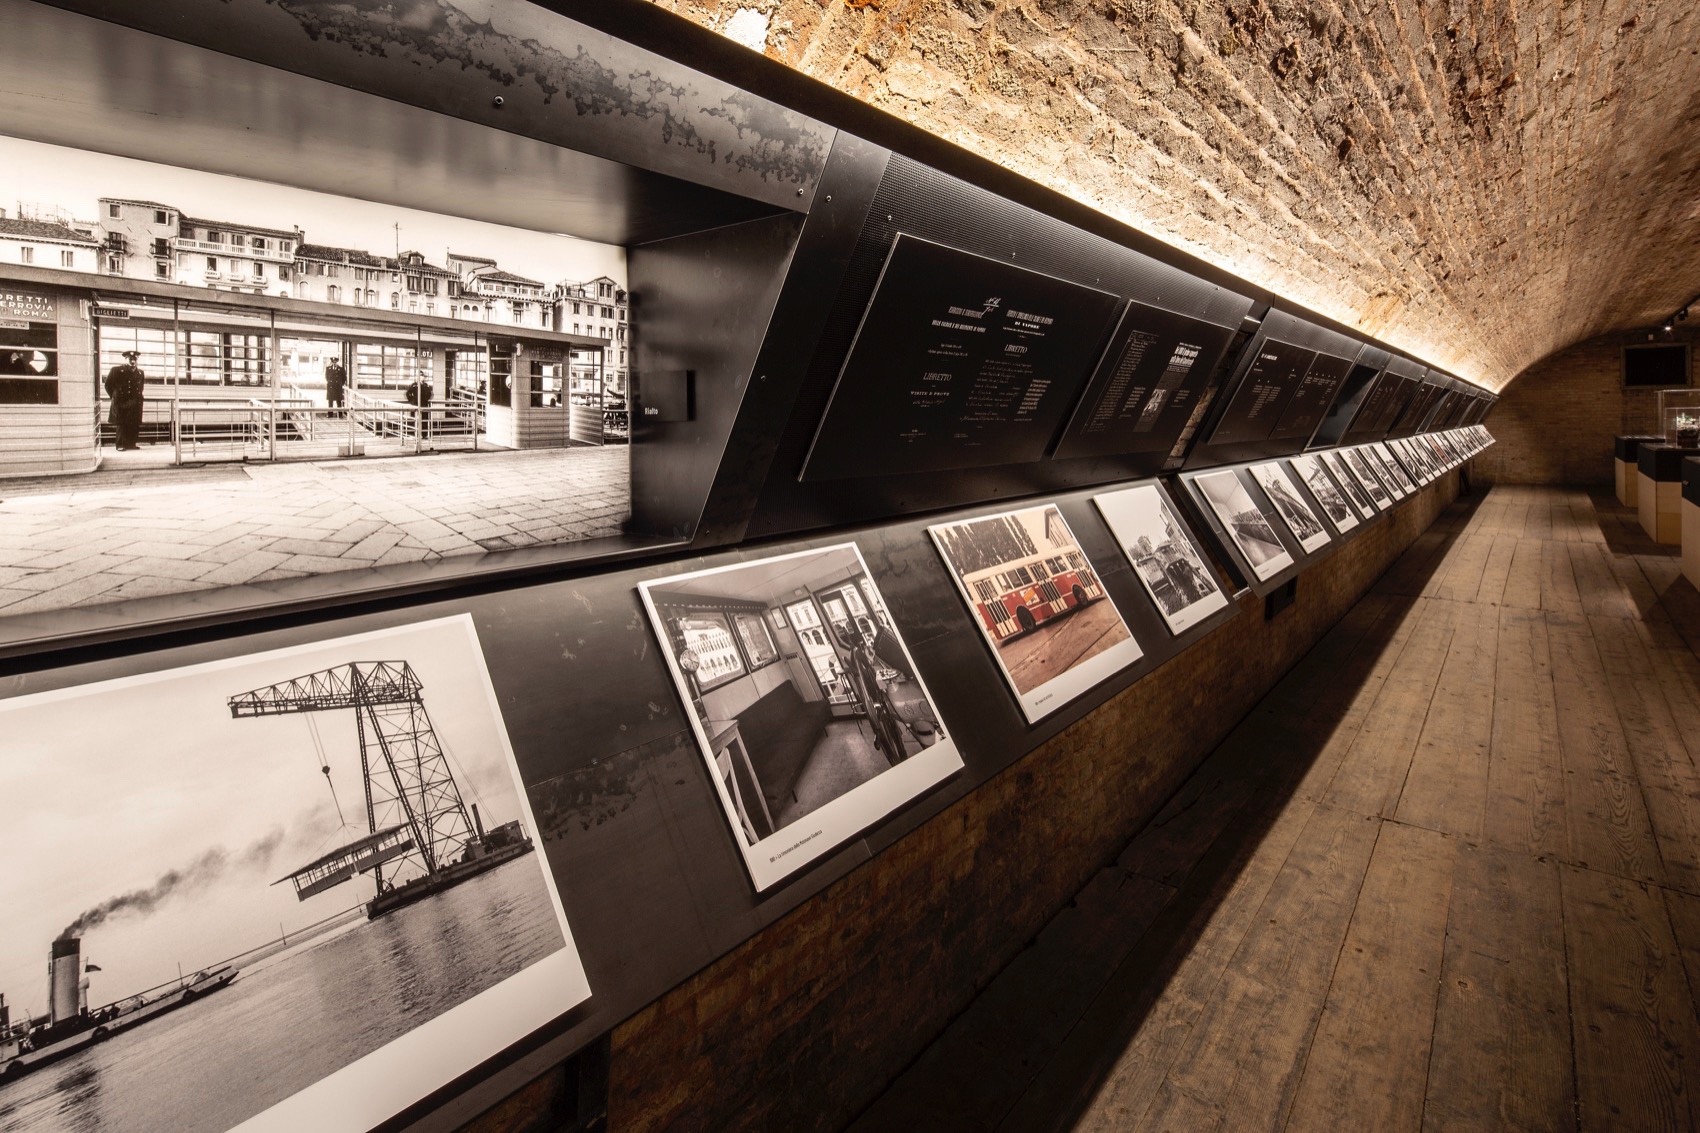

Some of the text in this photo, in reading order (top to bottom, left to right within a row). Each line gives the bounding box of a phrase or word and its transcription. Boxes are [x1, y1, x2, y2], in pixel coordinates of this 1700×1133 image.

[14, 309, 48, 317] ROMA
[96, 308, 128, 317] BIGLIETTI
[1004, 344, 1028, 354] LIBRETTO
[922, 372, 952, 382] LIBRETTO
[644, 407, 659, 415] Rialto
